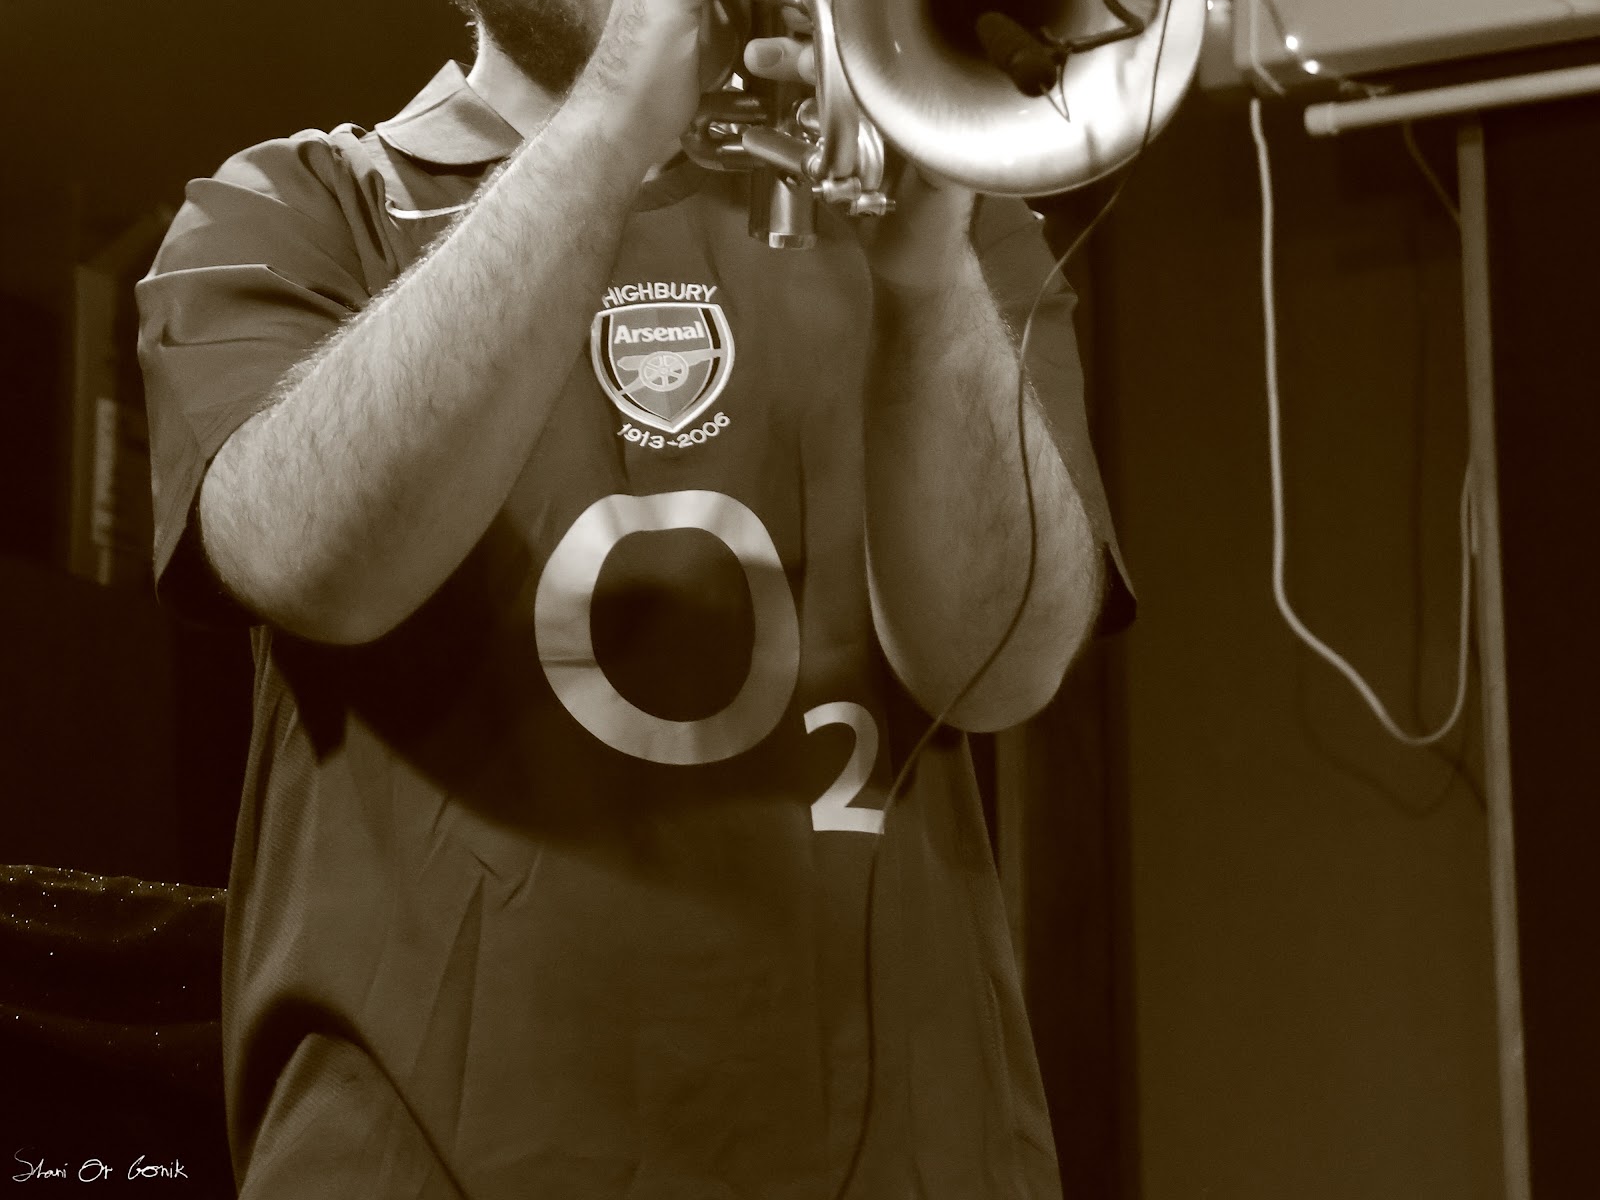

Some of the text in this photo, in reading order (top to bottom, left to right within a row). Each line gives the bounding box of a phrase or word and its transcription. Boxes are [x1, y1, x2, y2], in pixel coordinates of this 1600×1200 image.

[602, 282, 717, 308] HIGHBURY
[614, 321, 705, 344] Arsenal
[617, 412, 731, 449] 1913-2006
